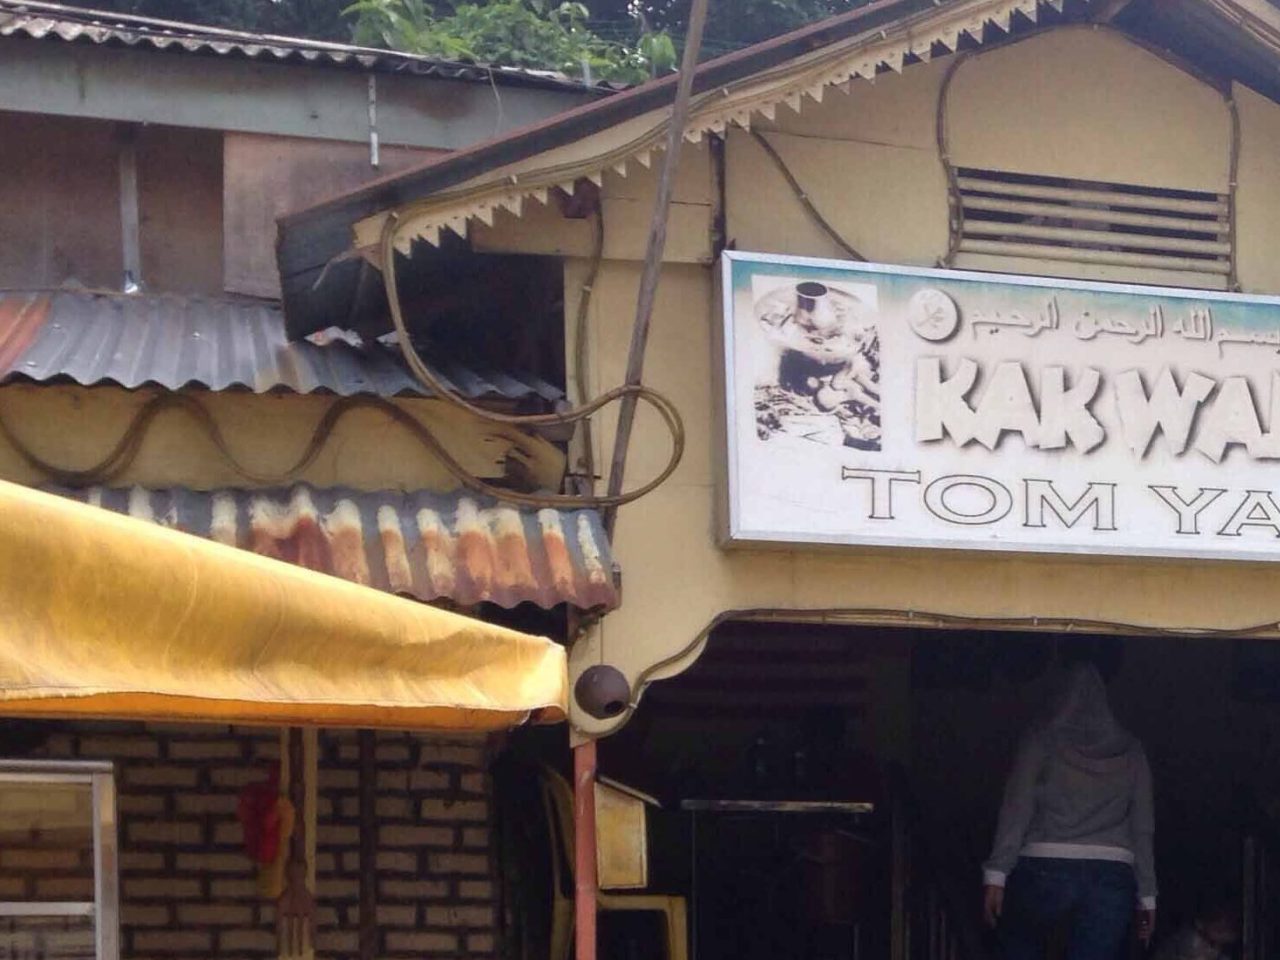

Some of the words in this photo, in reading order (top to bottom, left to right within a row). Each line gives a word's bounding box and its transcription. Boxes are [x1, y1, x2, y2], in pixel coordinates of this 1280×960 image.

[967, 295, 1060, 340] الرحيم
[1071, 302, 1165, 345] الرحمن
[1172, 304, 1214, 342] الله
[841, 465, 1118, 531] TOM
